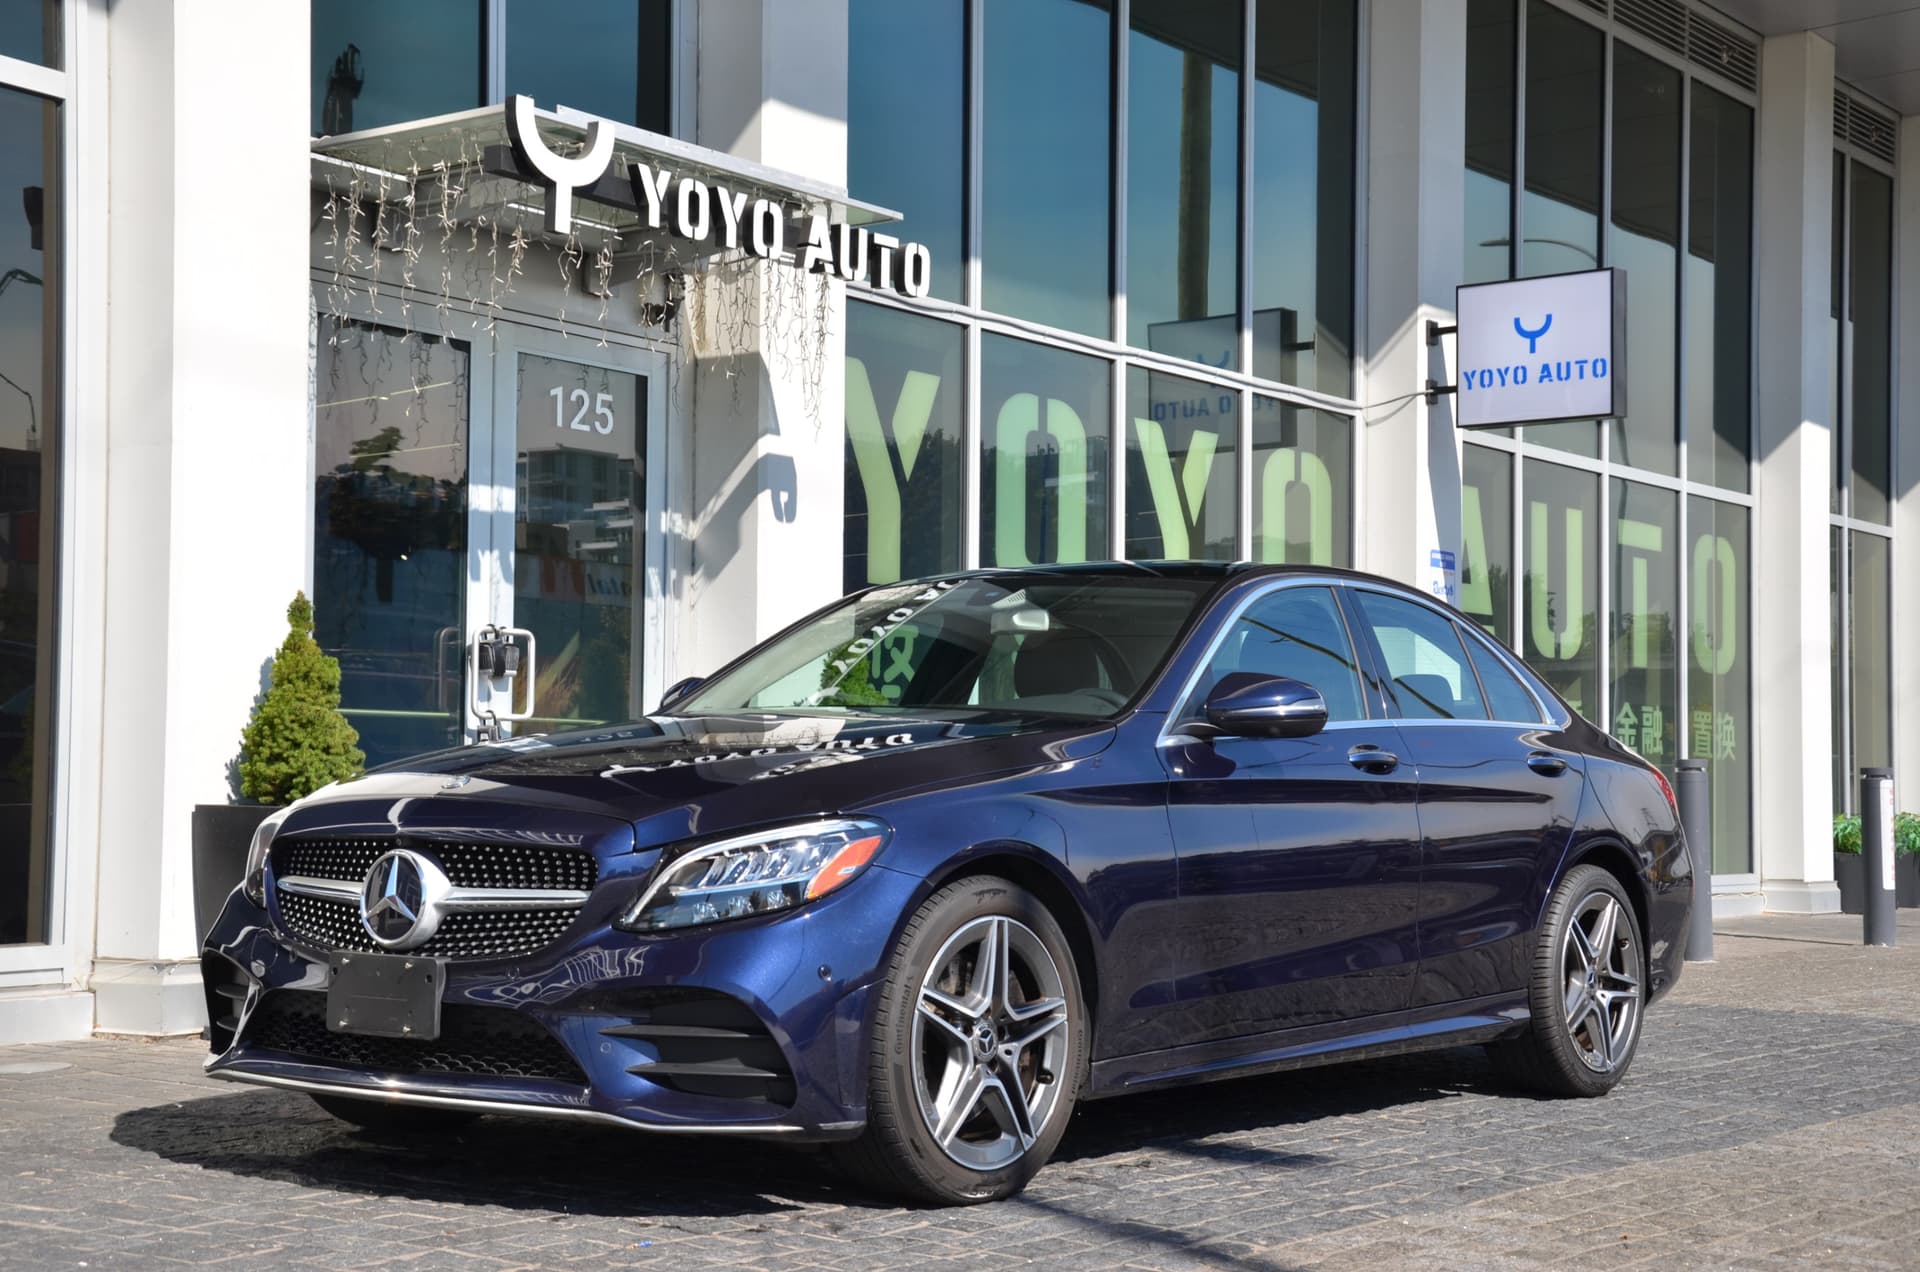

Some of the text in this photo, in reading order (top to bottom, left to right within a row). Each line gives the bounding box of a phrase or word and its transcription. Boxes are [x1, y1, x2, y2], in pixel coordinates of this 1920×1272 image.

[632, 162, 931, 298] YOYO AUTO
[1463, 357, 1608, 391] YOYO AUTO
[549, 385, 615, 436] 125
[845, 356, 1332, 586] YOYO
[1615, 701, 1736, 760] 金融 置换
